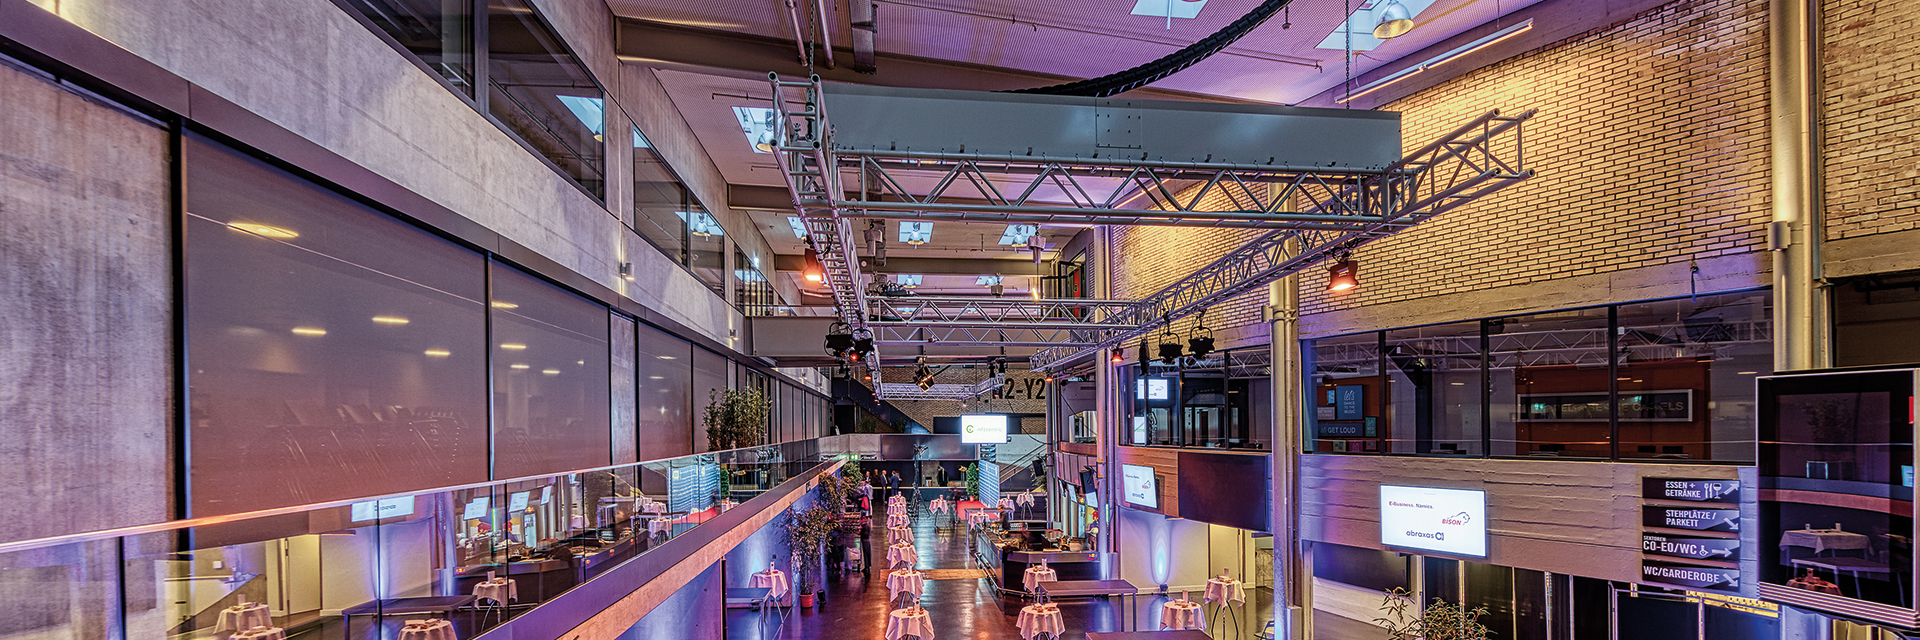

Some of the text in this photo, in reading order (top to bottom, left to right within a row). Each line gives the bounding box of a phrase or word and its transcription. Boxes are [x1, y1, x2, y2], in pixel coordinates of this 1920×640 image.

[1665, 481, 1688, 489] ESSEN
[1665, 488, 1701, 498] GETRÄNKE
[1666, 509, 1711, 520] STEHPLÄTZE
[1666, 518, 1699, 527] PARKETT
[1406, 530, 1434, 539] abraxas
[1643, 566, 1720, 583] WC/GARDEROBE
